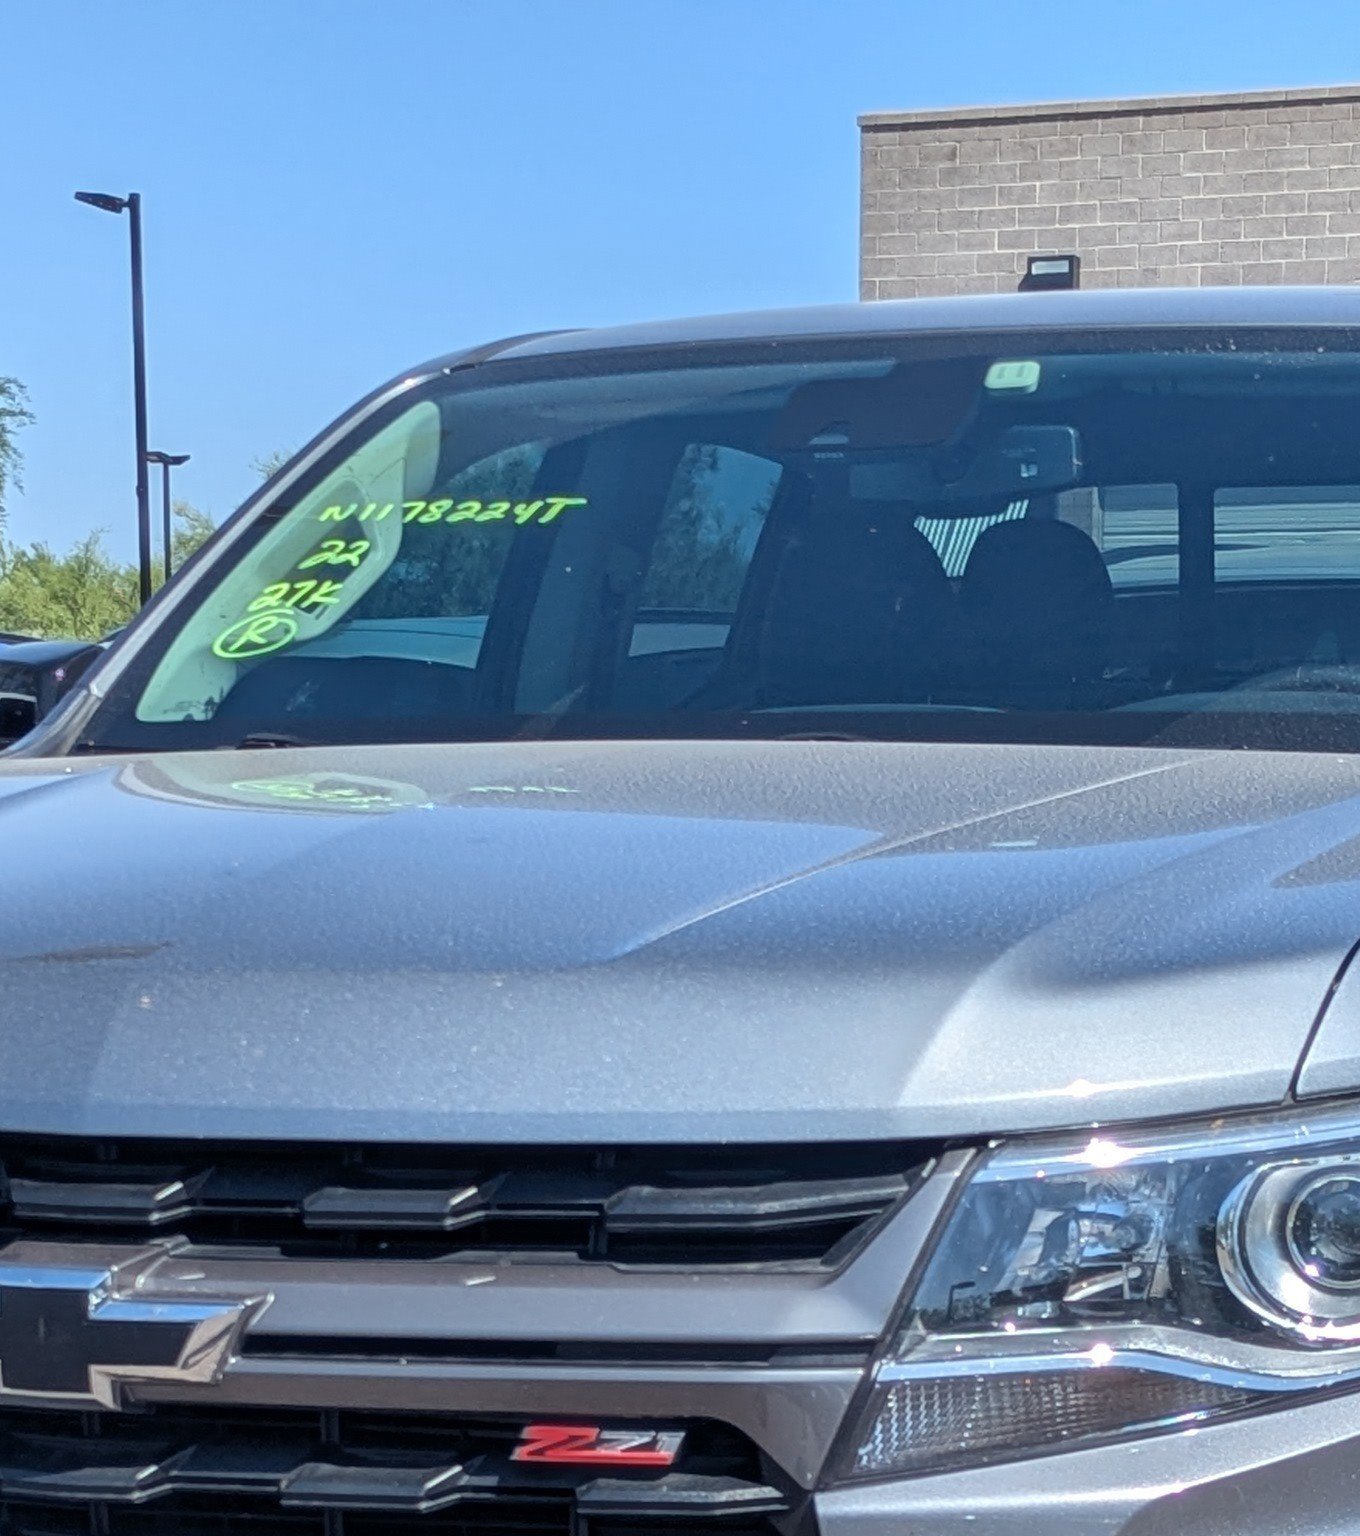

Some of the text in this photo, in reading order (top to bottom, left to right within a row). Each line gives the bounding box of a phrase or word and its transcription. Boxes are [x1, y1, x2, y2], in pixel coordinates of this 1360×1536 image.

[299, 540, 370, 569] 22
[248, 580, 343, 611] 27K
[510, 1425, 687, 1465] Z71
